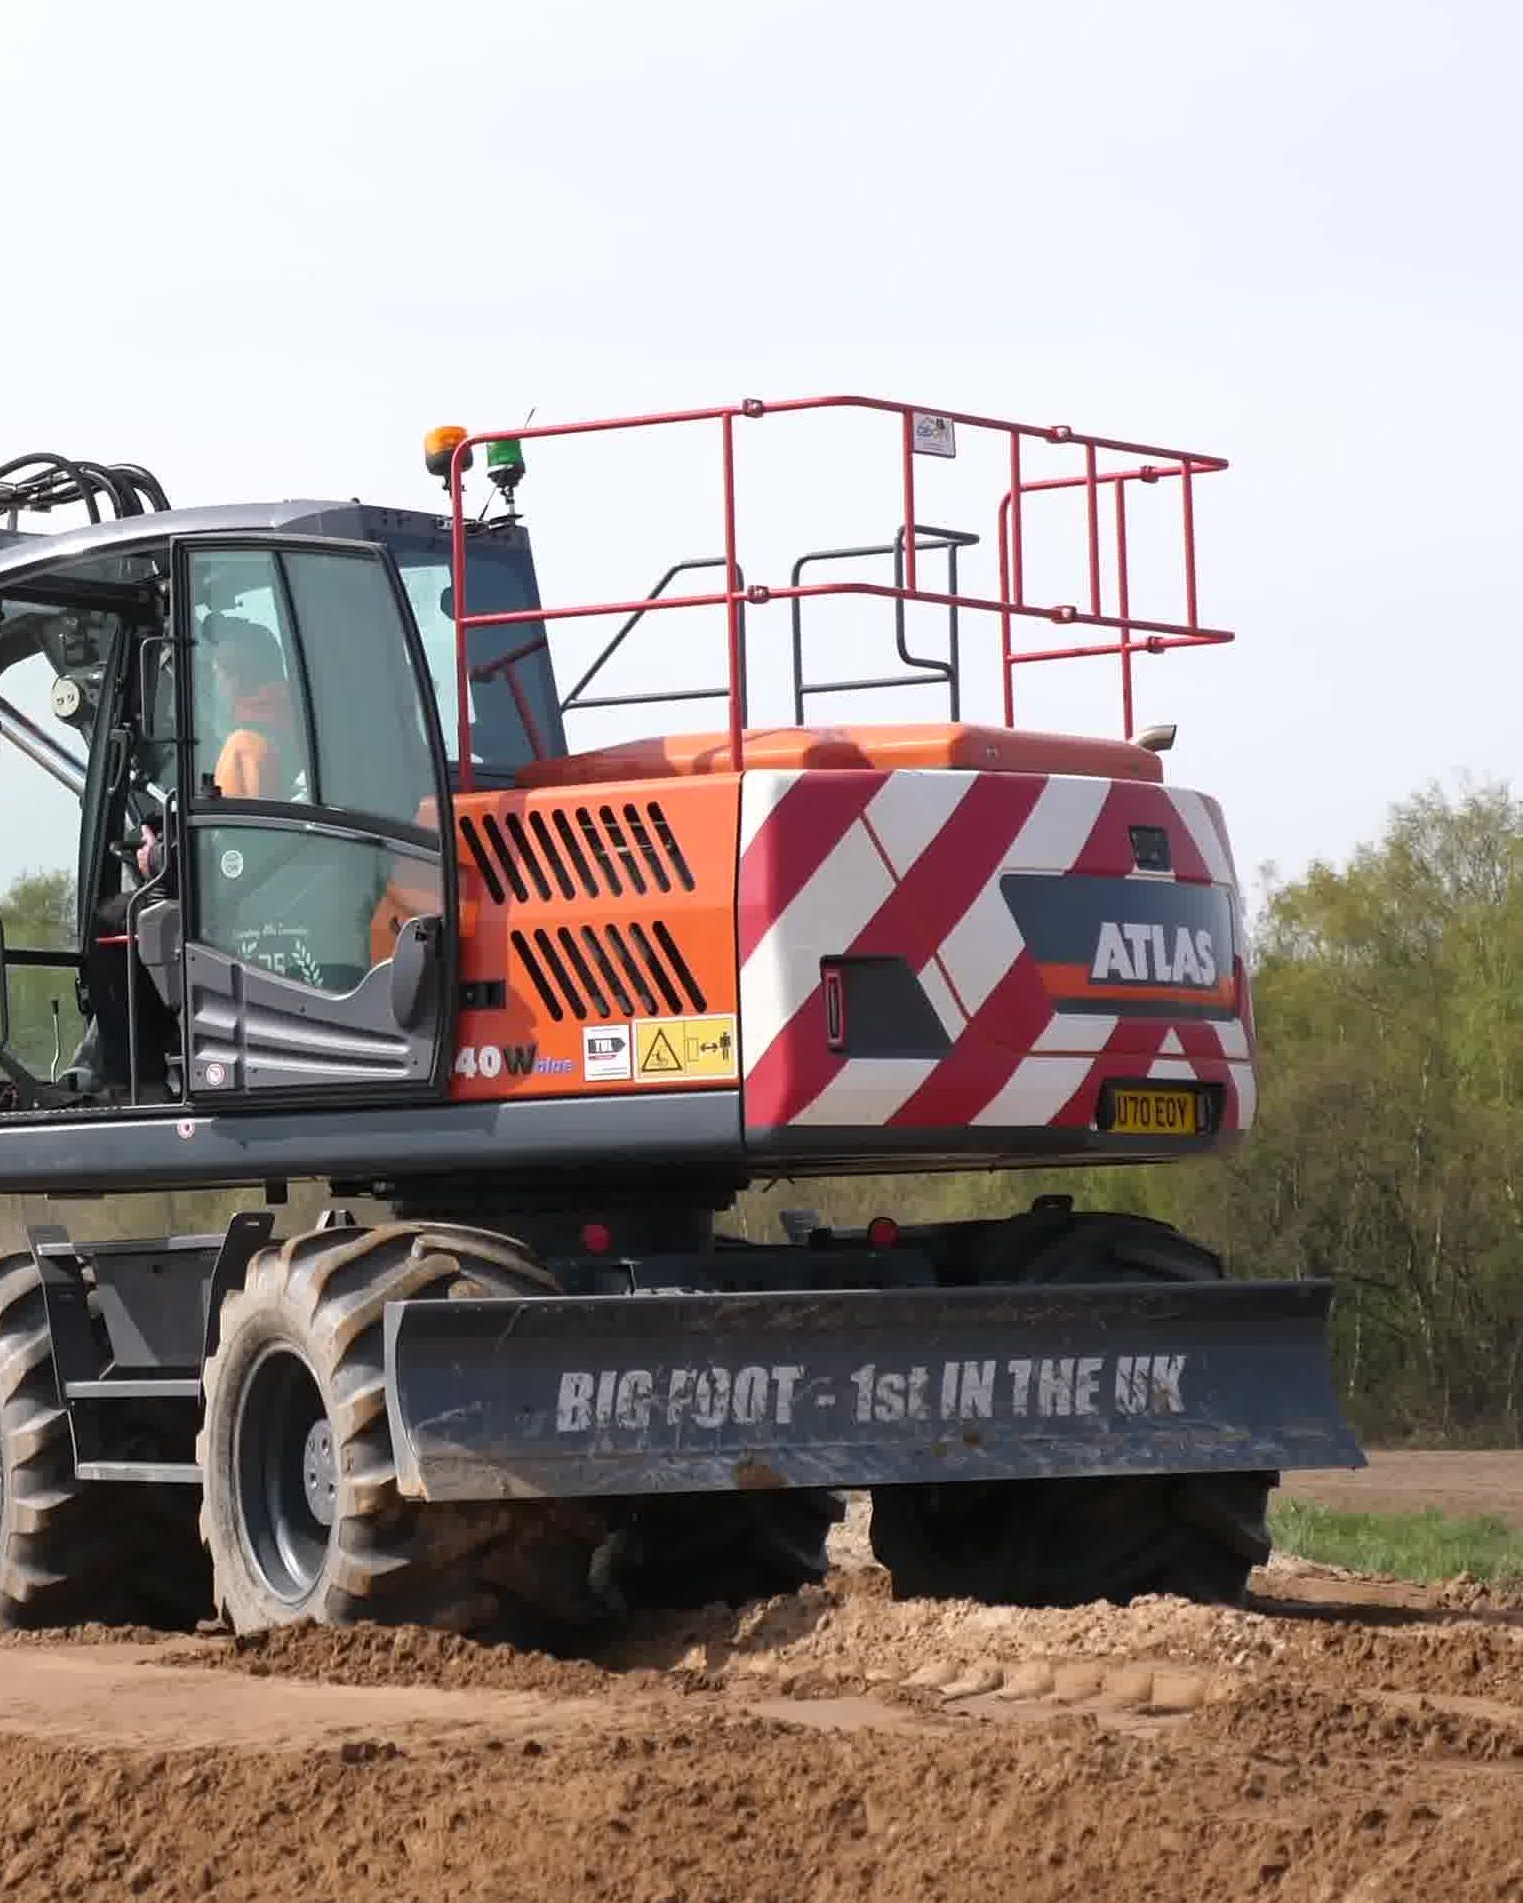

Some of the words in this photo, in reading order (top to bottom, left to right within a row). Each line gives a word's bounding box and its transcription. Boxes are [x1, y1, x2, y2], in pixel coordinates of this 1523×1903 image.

[1091, 921, 1217, 987] ATLAS
[556, 1369, 653, 1432] BIG
[666, 1365, 804, 1428] FOOT
[850, 1363, 928, 1423] 1st
[940, 1360, 997, 1420] IN
[1008, 1357, 1105, 1418] THE
[1114, 1354, 1188, 1418] UK
